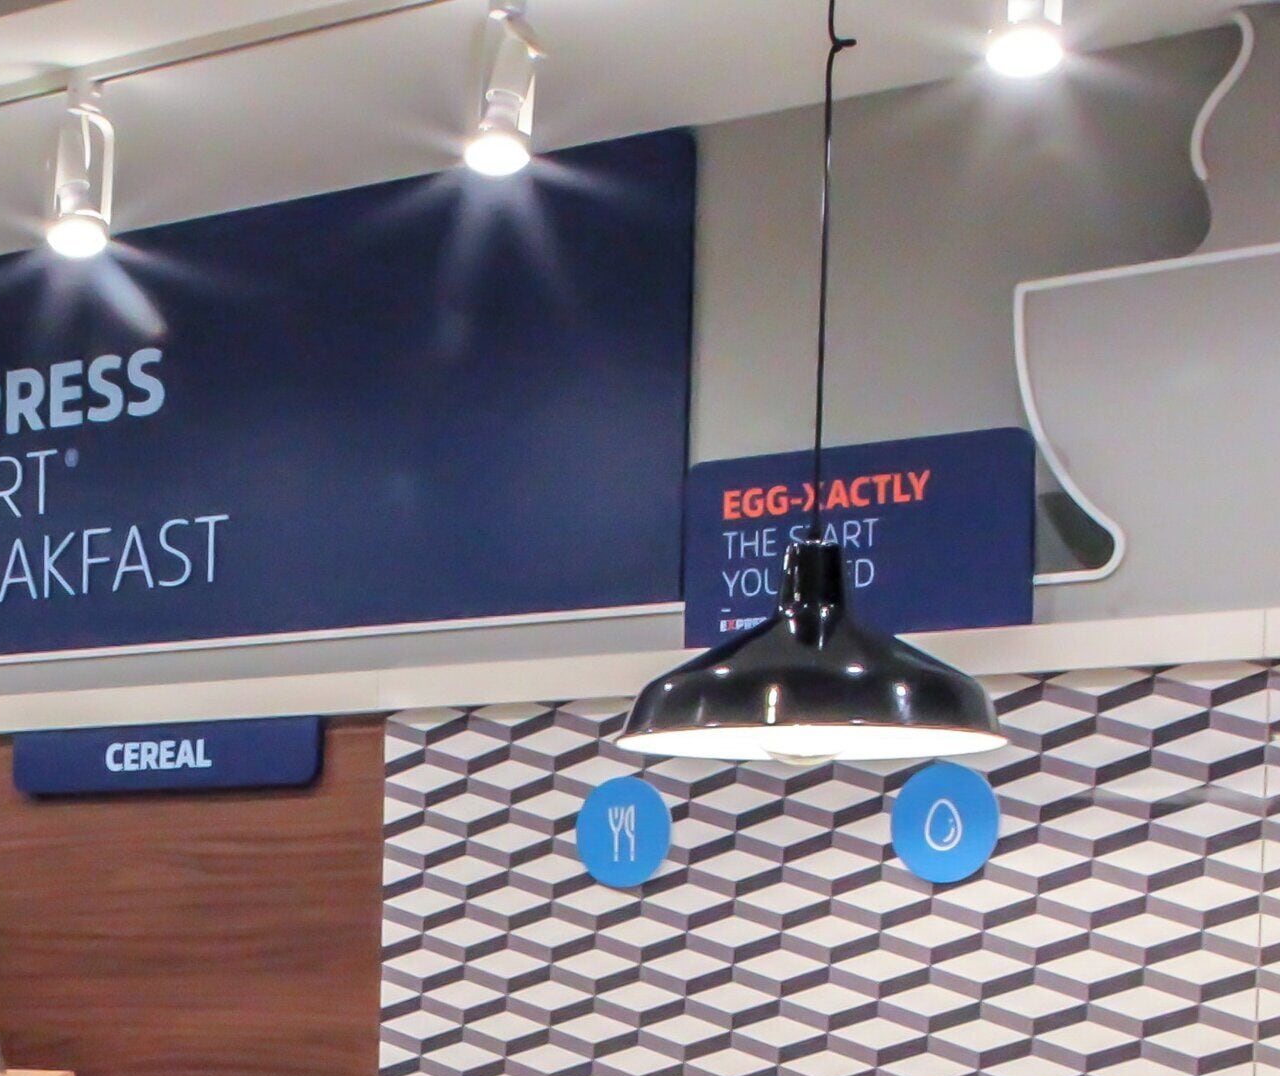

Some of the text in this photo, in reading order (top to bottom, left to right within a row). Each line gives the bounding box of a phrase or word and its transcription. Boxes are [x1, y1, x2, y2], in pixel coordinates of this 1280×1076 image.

[722, 518, 880, 560] THE SART
[106, 739, 212, 772] CEREAL
